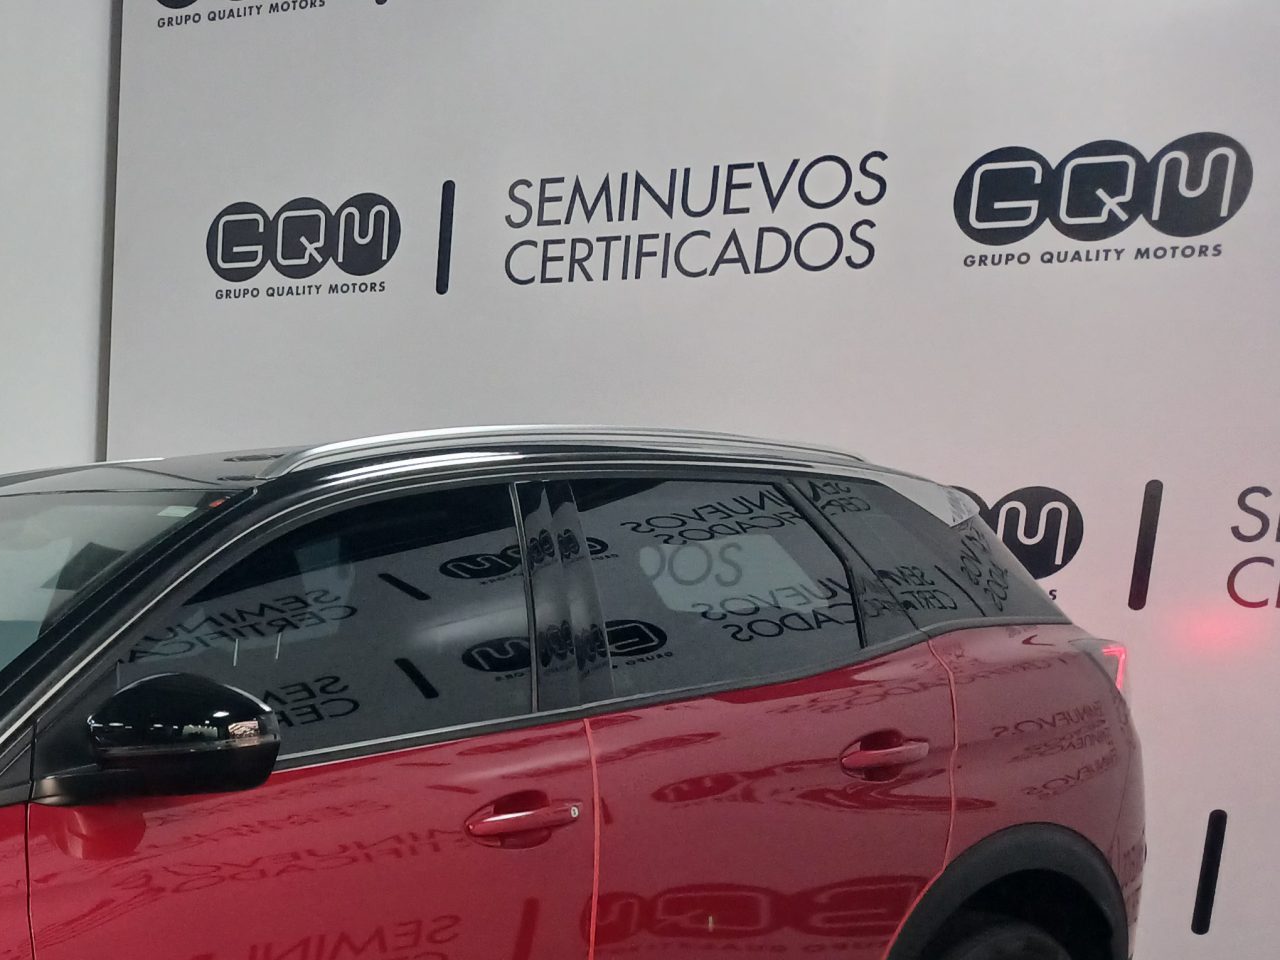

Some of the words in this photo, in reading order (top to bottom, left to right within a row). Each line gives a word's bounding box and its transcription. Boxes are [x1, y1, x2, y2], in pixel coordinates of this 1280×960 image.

[157, 12, 202, 28] GRUPO
[207, 4, 263, 22] QUALITY
[268, 0, 326, 14] MOTORS
[504, 150, 889, 229] SEMINUEVOS
[967, 145, 1238, 231] GQM
[215, 203, 391, 270] GQM
[504, 218, 877, 286] CERTIFICADOS
[963, 251, 1032, 268] GRUPO
[1040, 248, 1126, 265] QUALITY
[1134, 243, 1223, 260] MOTORS
[215, 286, 260, 300] GRUPO
[266, 284, 322, 297] QUALITY
[328, 281, 386, 295] MOTORS
[1231, 485, 1280, 543] S
[1227, 555, 1280, 609] C
